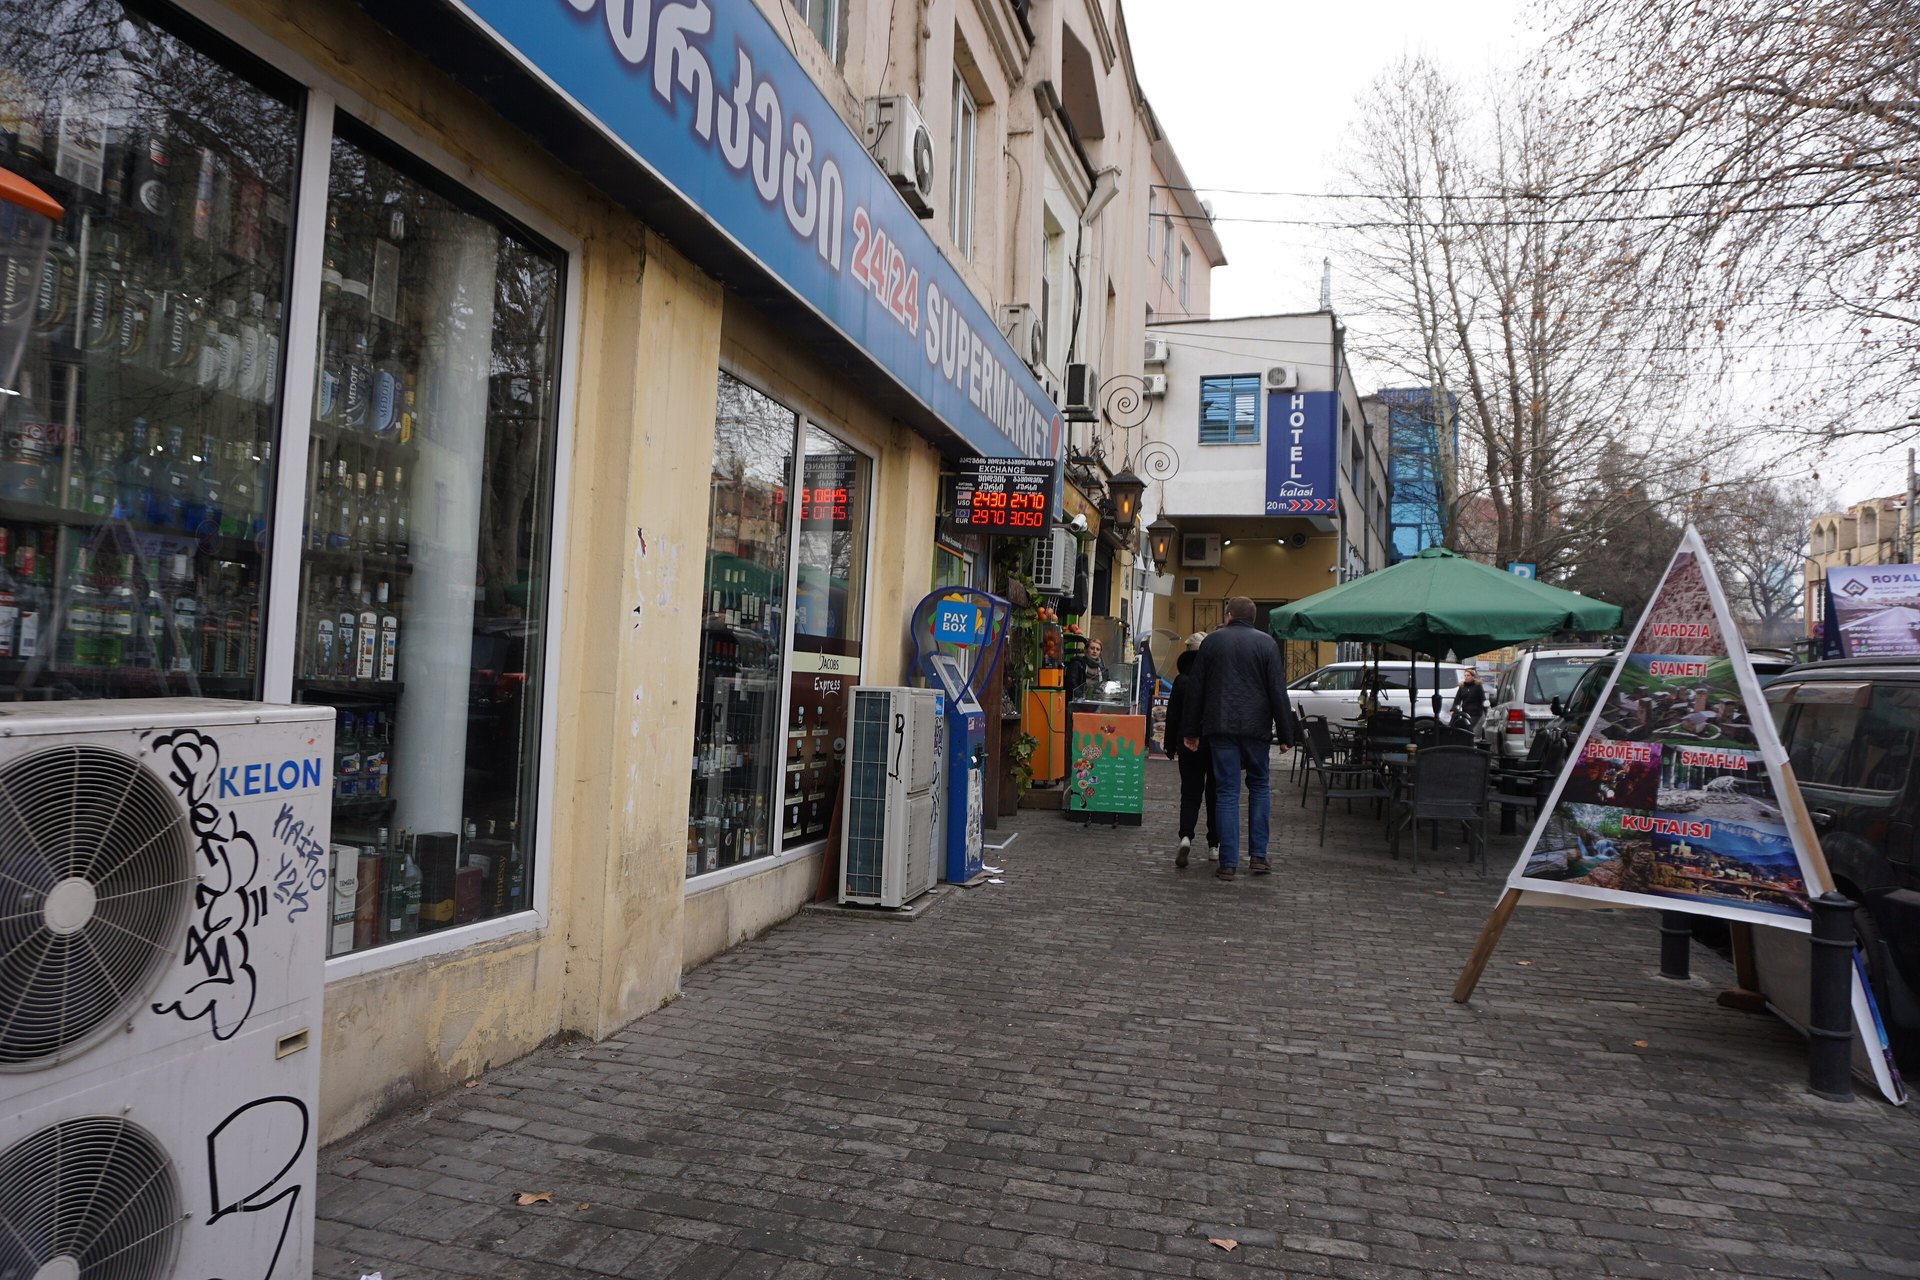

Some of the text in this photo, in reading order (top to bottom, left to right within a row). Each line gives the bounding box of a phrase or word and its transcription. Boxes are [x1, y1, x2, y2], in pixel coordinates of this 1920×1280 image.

[568, 0, 1048, 459] რკეტი 24/24 SUPERMARKET
[40, 261, 54, 310] MEDOFF
[92, 281, 106, 329] MEDOFF
[120, 306, 132, 346] MEDOFF
[171, 303, 184, 353] MEDOFF
[348, 365, 359, 406] MEDOFF
[1290, 394, 1305, 479] HOTEL
[978, 465, 1026, 474] EXCHANGE
[1280, 487, 1314, 497] kalasi
[1266, 501, 1278, 510] 20
[1871, 573, 1920, 584] ROYAL
[942, 622, 967, 633] BOX
[943, 612, 968, 624] PAY
[1652, 622, 1711, 639] VARDZIA
[1649, 660, 1709, 679] SVANETI
[814, 676, 841, 699] Express
[1587, 743, 1651, 763] PROMETE
[1680, 750, 1749, 771] SATAFLIA
[219, 758, 321, 799] KELON
[1620, 814, 1712, 840] KUTAISI
